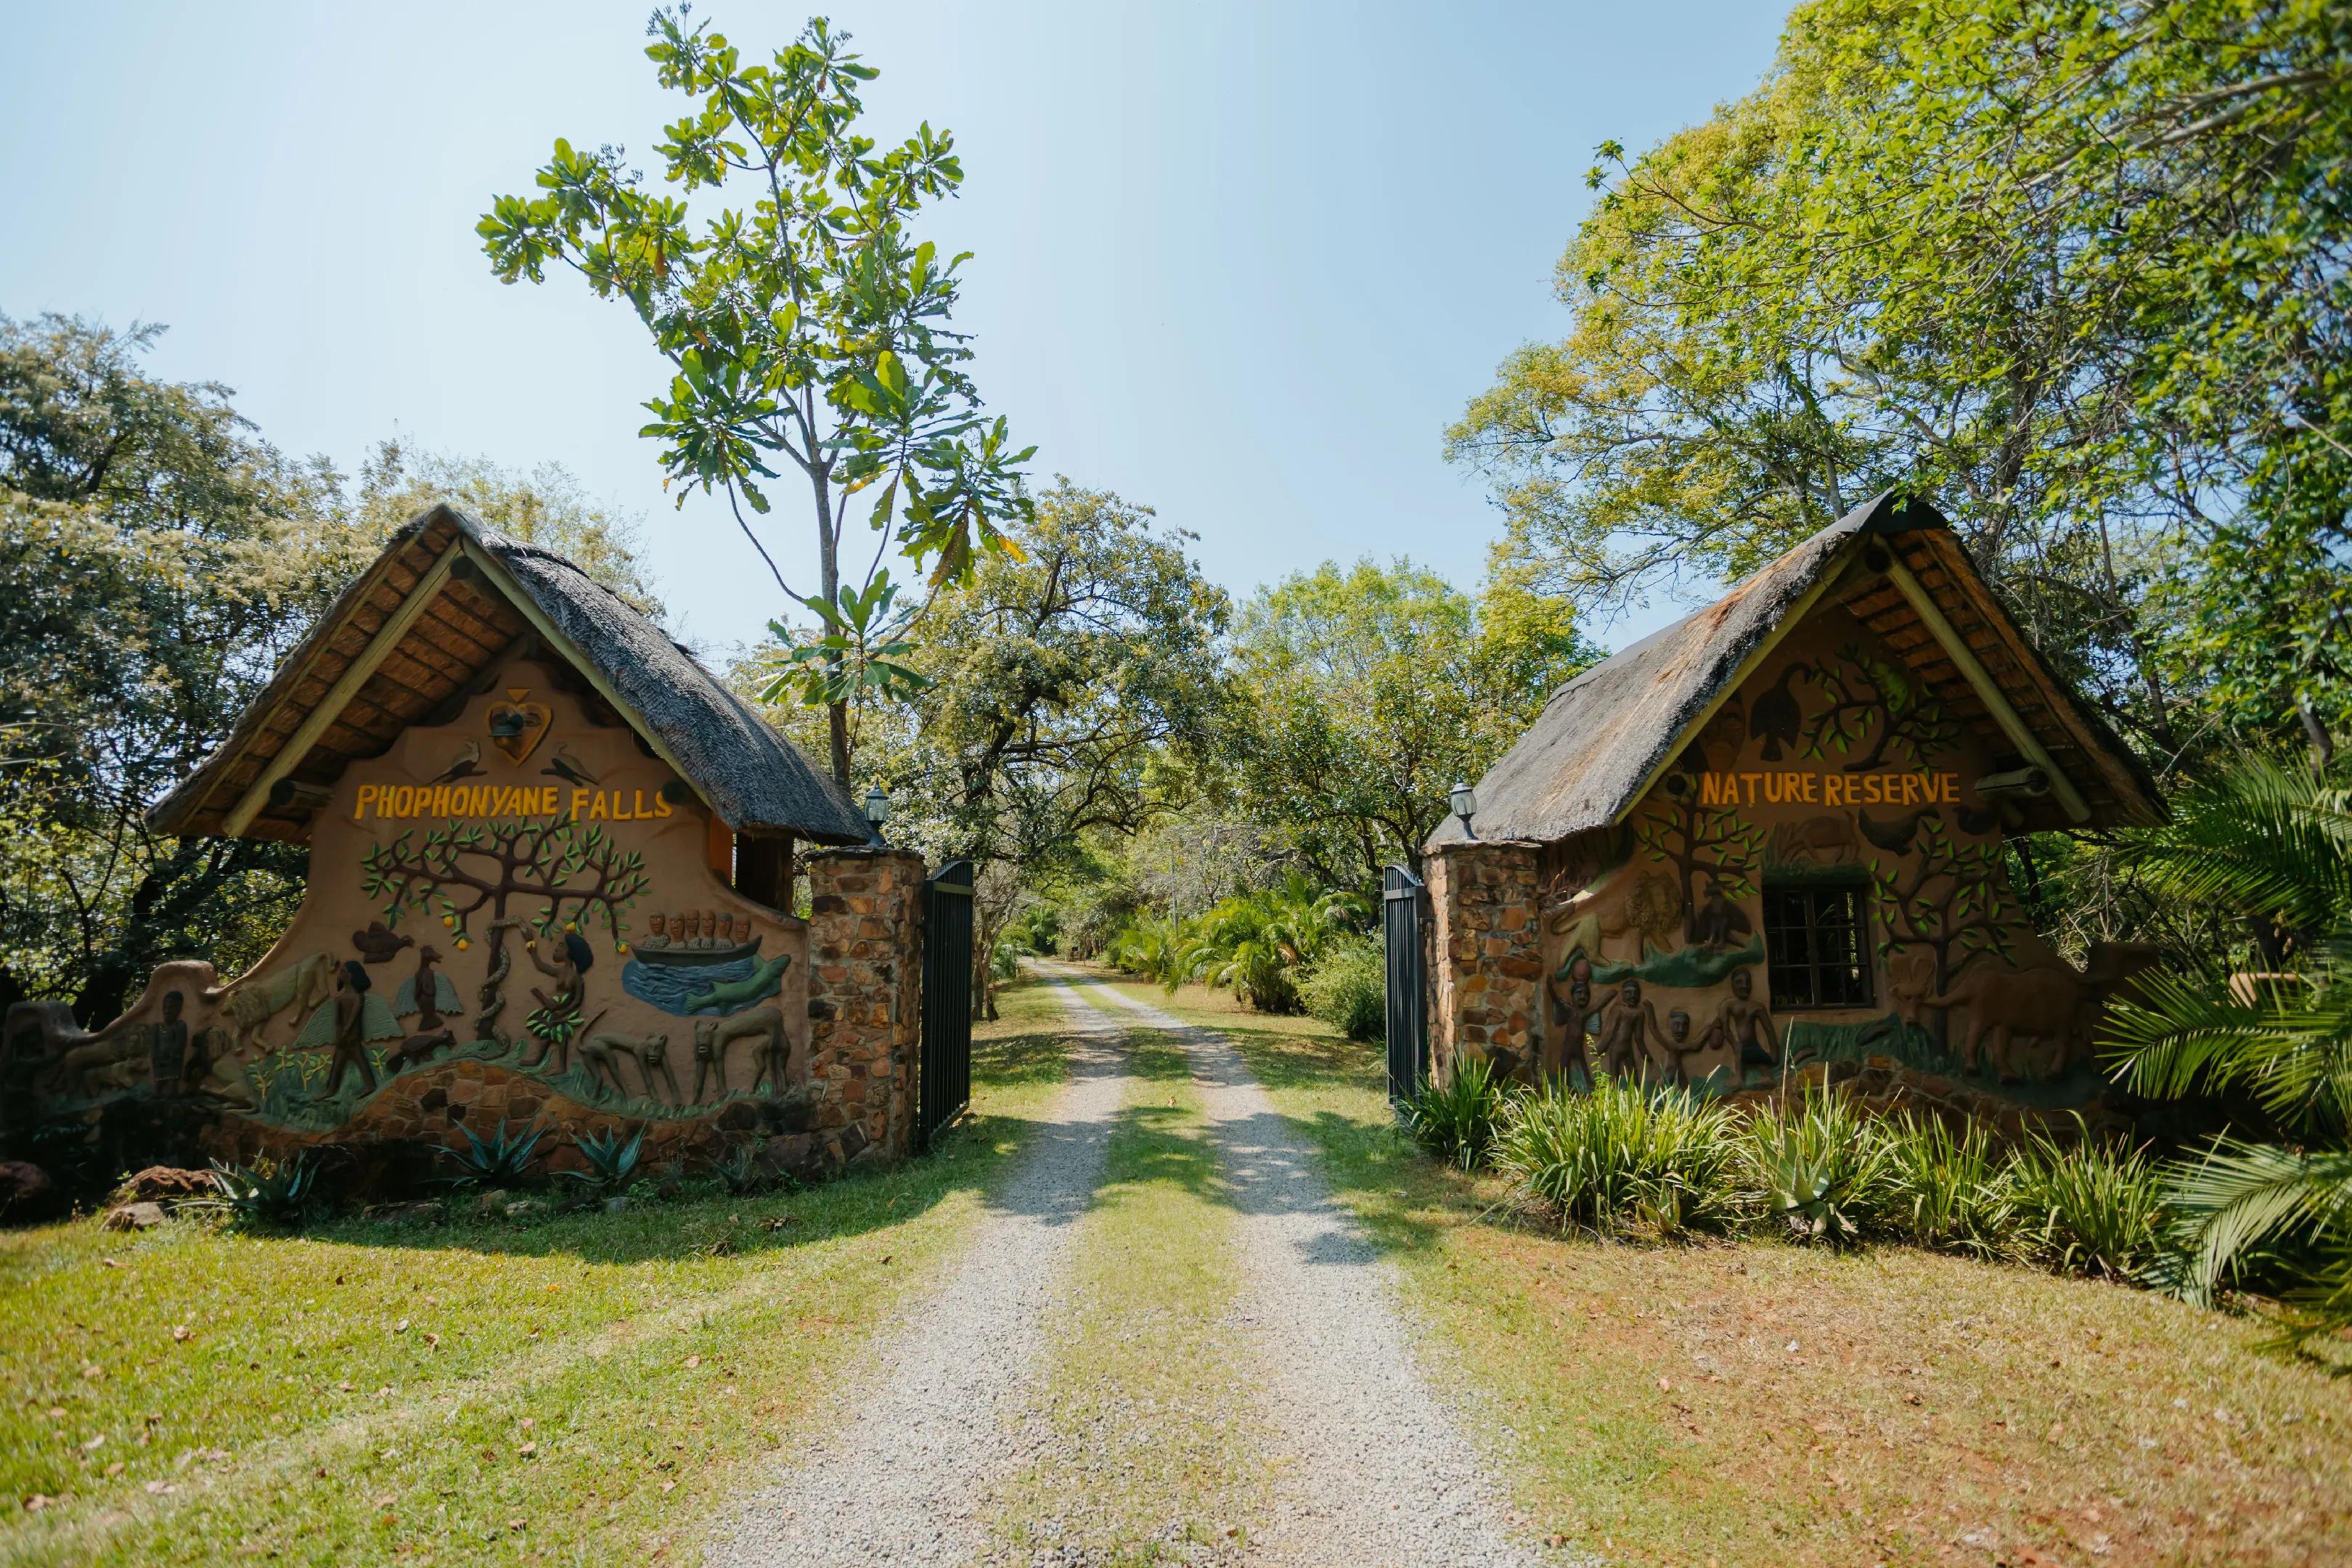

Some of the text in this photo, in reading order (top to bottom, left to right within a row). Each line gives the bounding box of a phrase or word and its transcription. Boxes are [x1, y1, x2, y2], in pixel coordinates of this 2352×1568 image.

[354, 785, 674, 821] PHOPHONYANE FALLS
[1702, 772, 1959, 806] NATURE RESERVE
